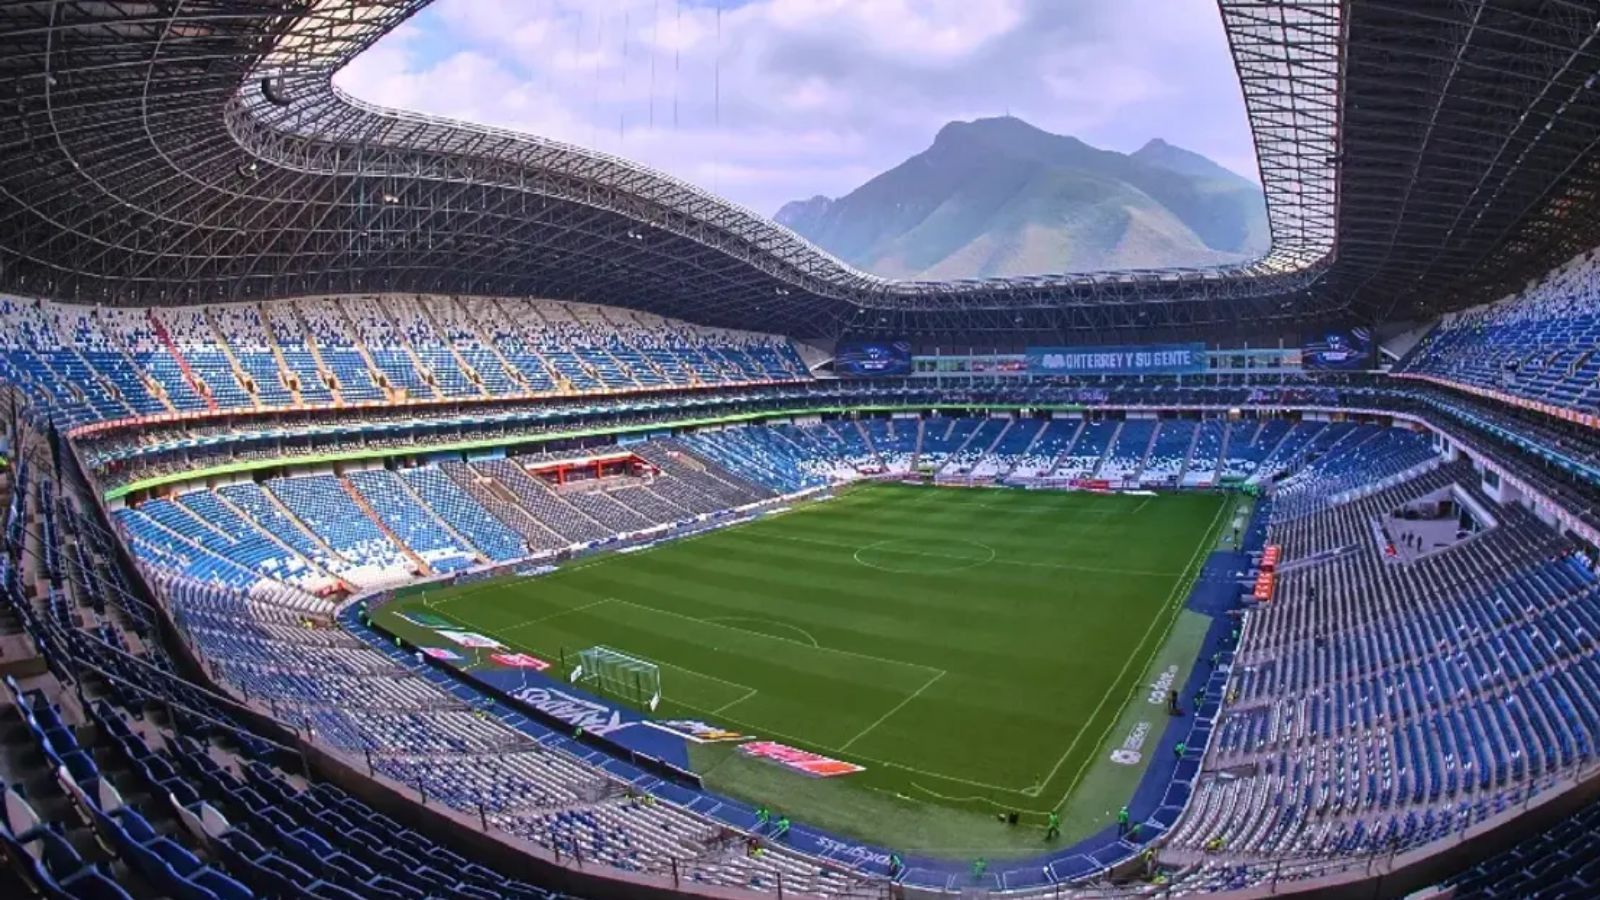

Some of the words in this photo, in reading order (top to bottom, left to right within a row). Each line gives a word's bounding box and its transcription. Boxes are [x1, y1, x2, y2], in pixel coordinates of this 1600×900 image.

[1125, 353, 1134, 367] Y
[1135, 352, 1151, 367] SU
[1154, 350, 1191, 366] GENTE
